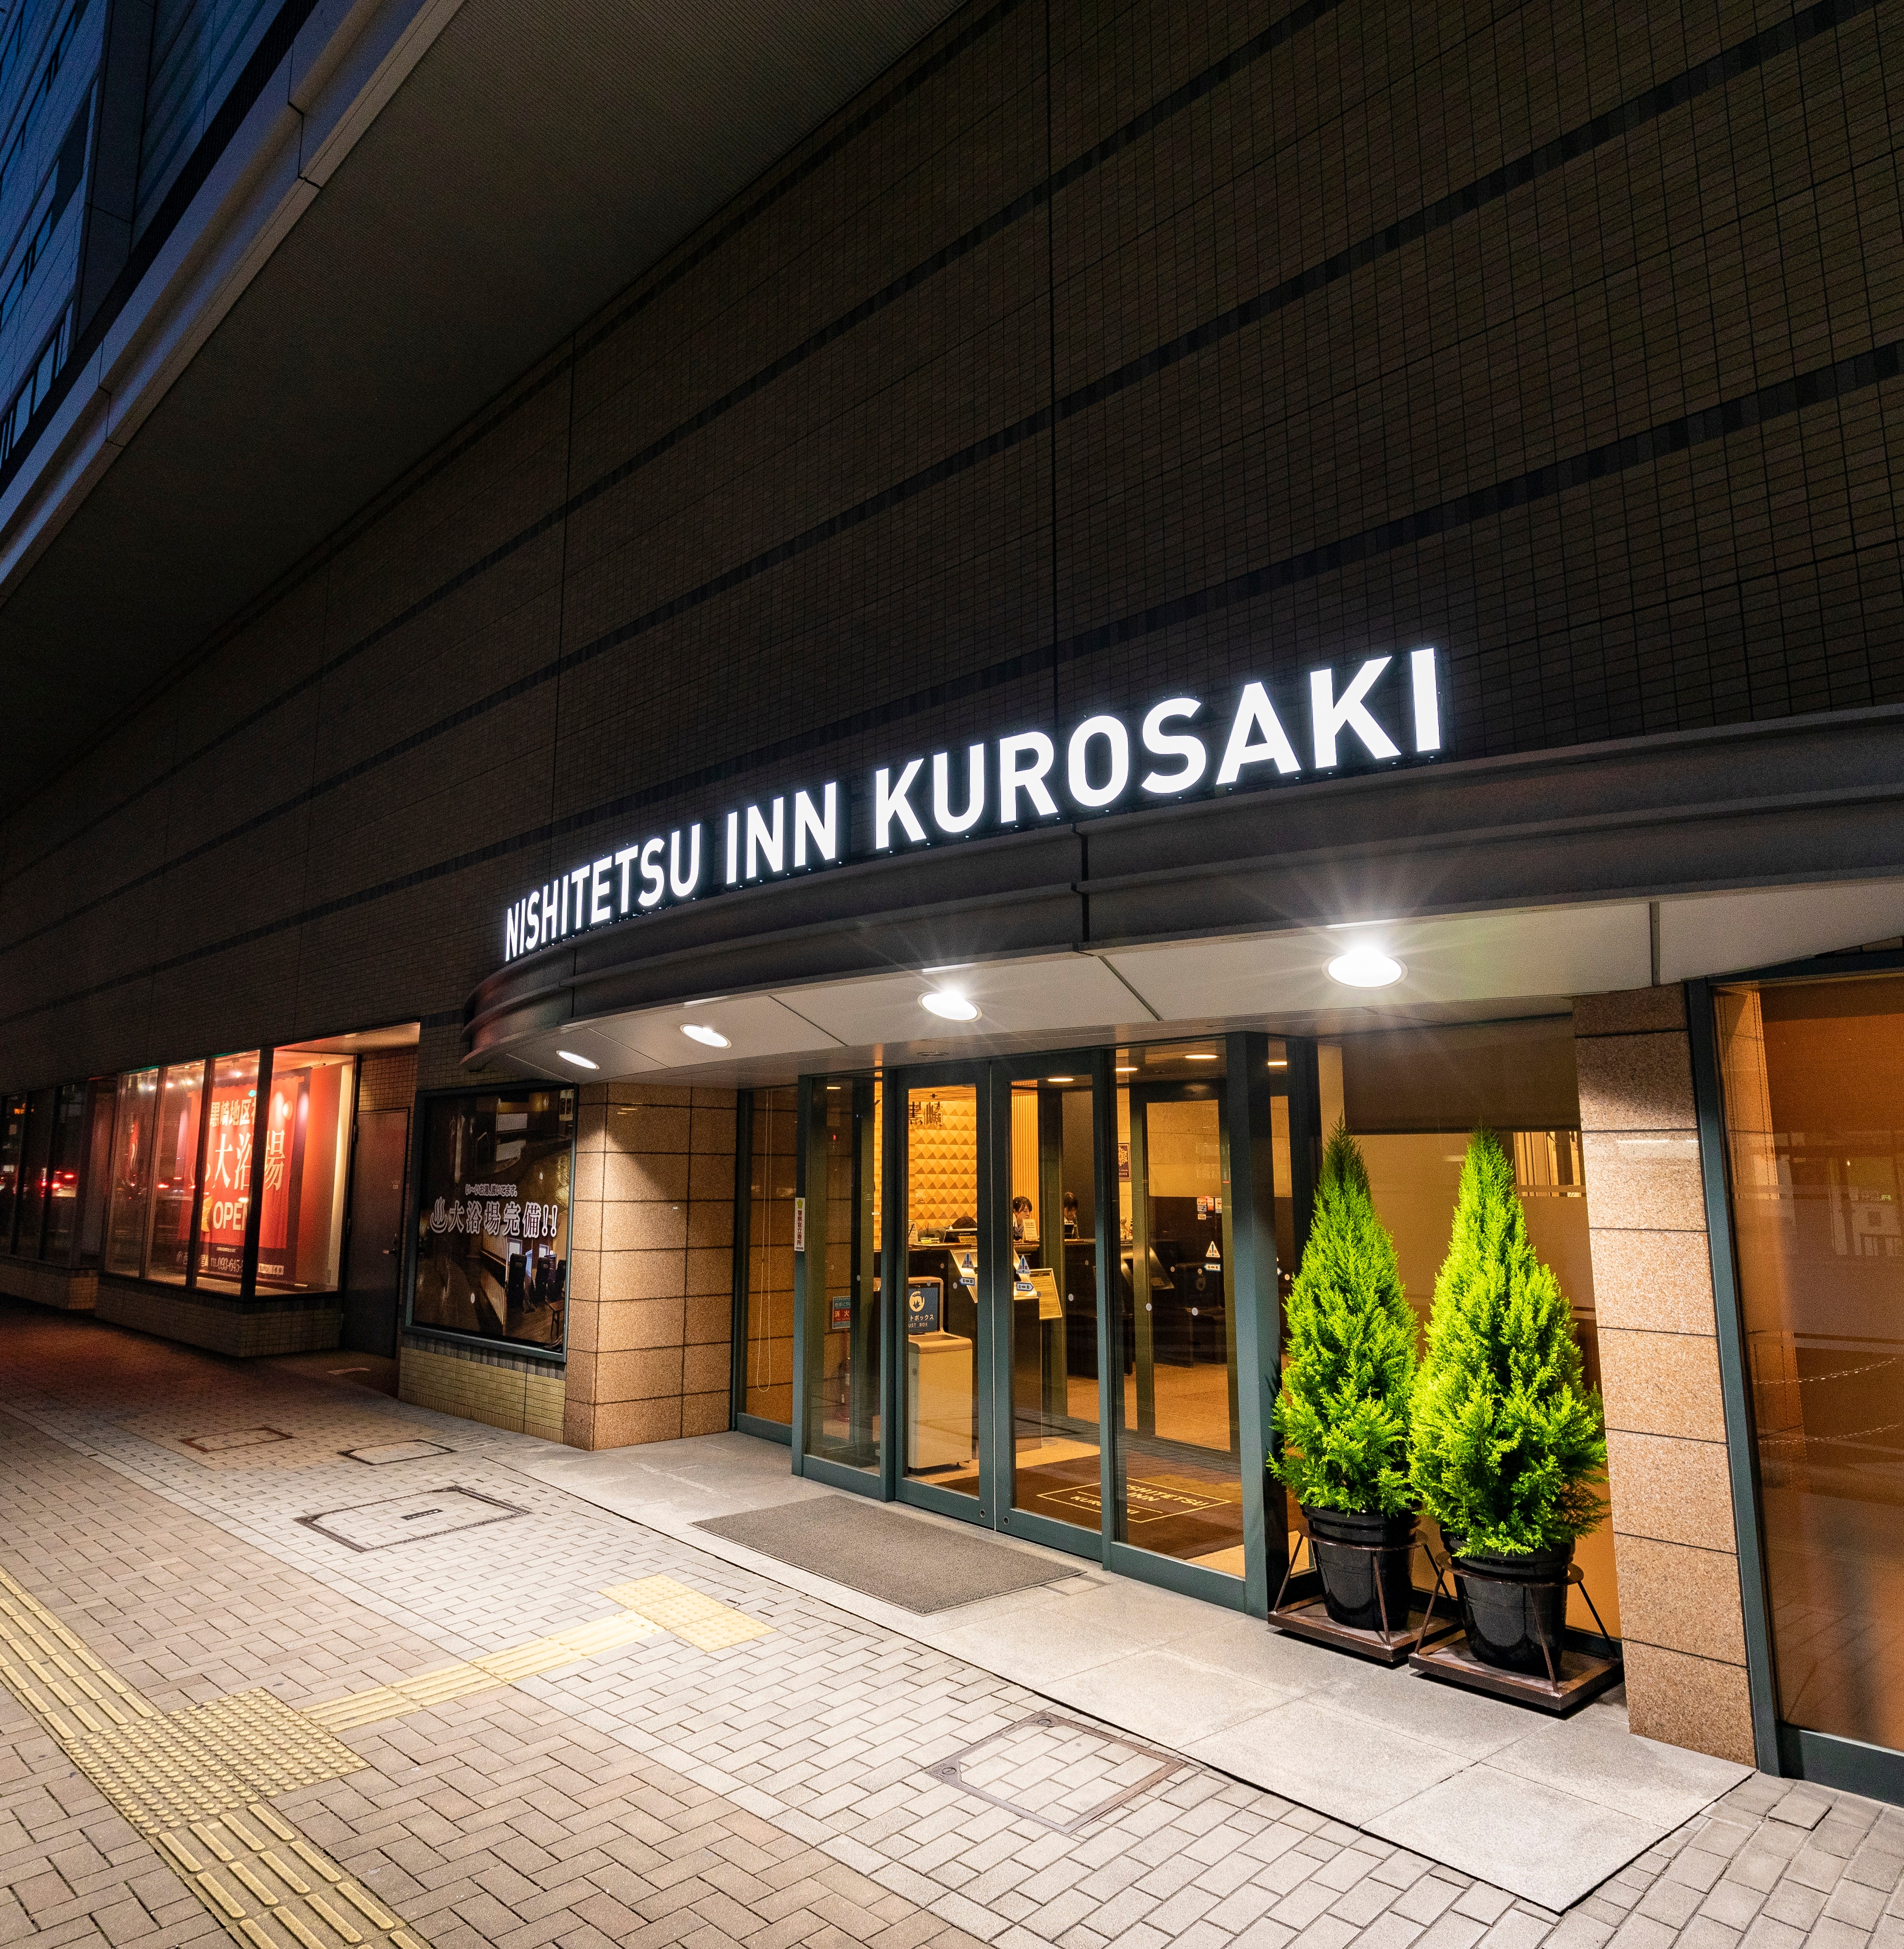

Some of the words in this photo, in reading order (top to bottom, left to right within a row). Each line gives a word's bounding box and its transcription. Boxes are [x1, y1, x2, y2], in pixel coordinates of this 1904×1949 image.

[505, 823, 701, 962] NISHITETSU
[726, 781, 837, 885] INN
[875, 648, 1440, 850] KUROSAKI
[1127, 1485, 1210, 1506] SHITETSU
